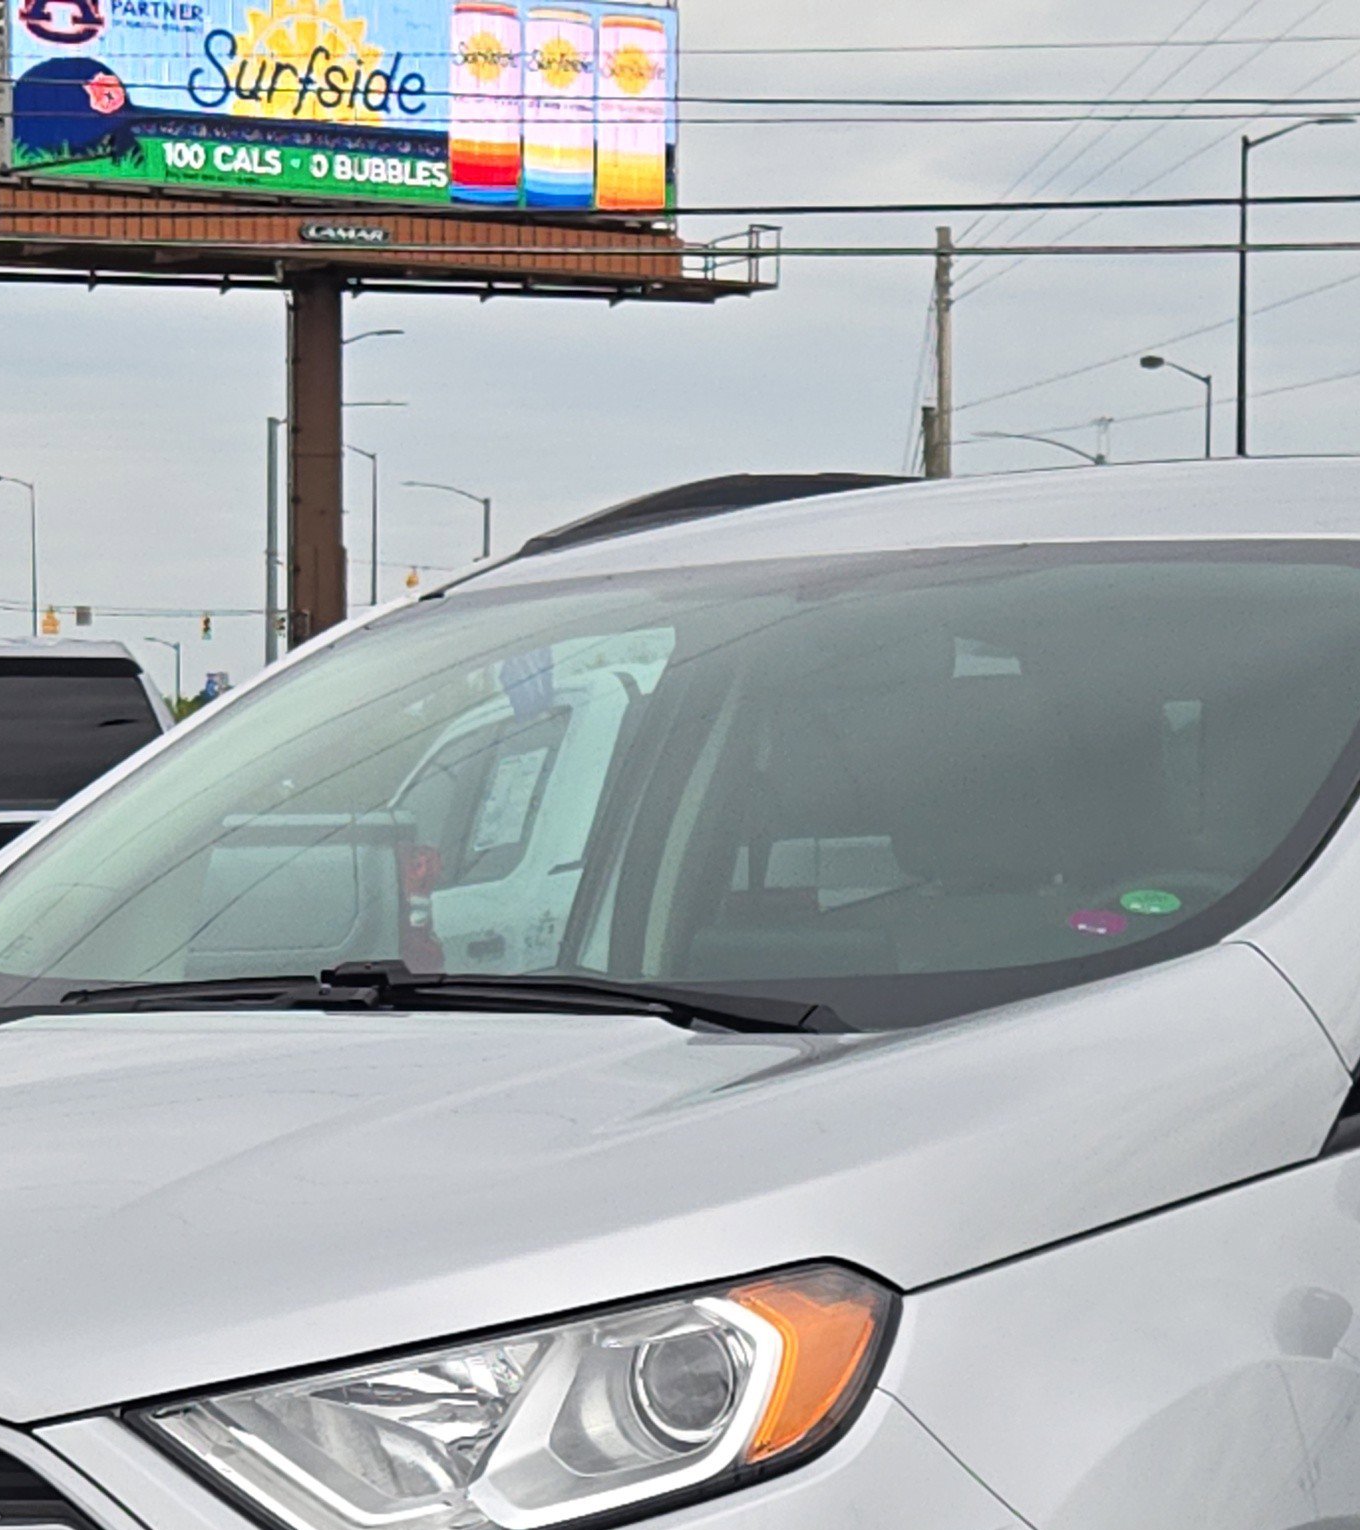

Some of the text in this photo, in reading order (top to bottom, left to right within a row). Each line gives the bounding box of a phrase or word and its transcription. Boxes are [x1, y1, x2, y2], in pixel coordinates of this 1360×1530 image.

[112, 0, 203, 21] PARTNER
[188, 28, 427, 115] Surfside
[162, 142, 206, 169] 100
[213, 145, 282, 175] CALS
[333, 155, 449, 187] BUBBLES
